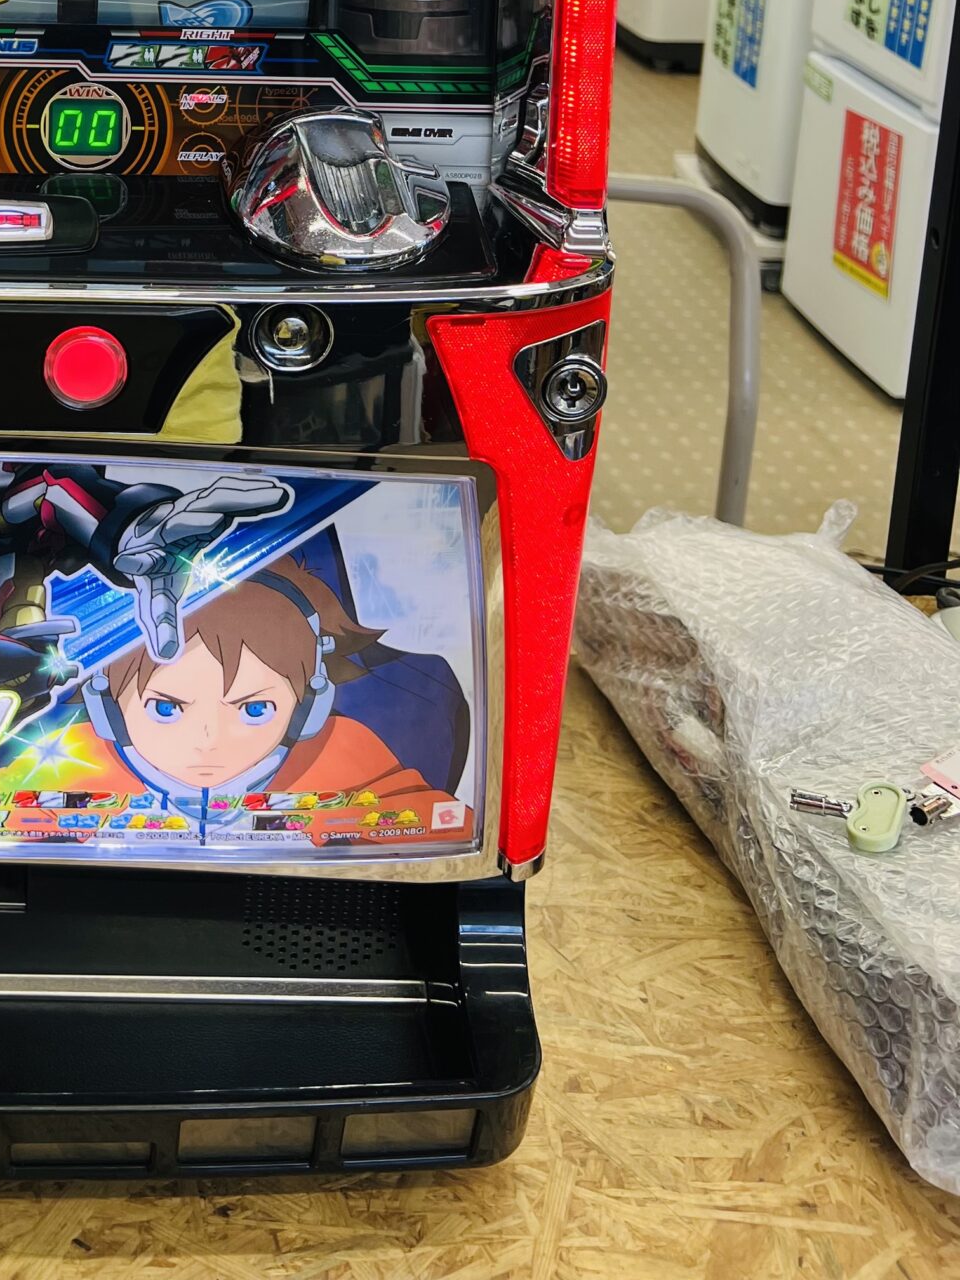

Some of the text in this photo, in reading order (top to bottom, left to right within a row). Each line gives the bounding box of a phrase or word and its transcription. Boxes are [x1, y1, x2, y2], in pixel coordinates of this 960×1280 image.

[180, 29, 235, 41] RIGHT
[66, 86, 106, 98] WIN
[180, 101, 196, 110] IN
[177, 151, 226, 162] REPLAY
[378, 828, 401, 836] 2009
[402, 827, 426, 835] NBGI
